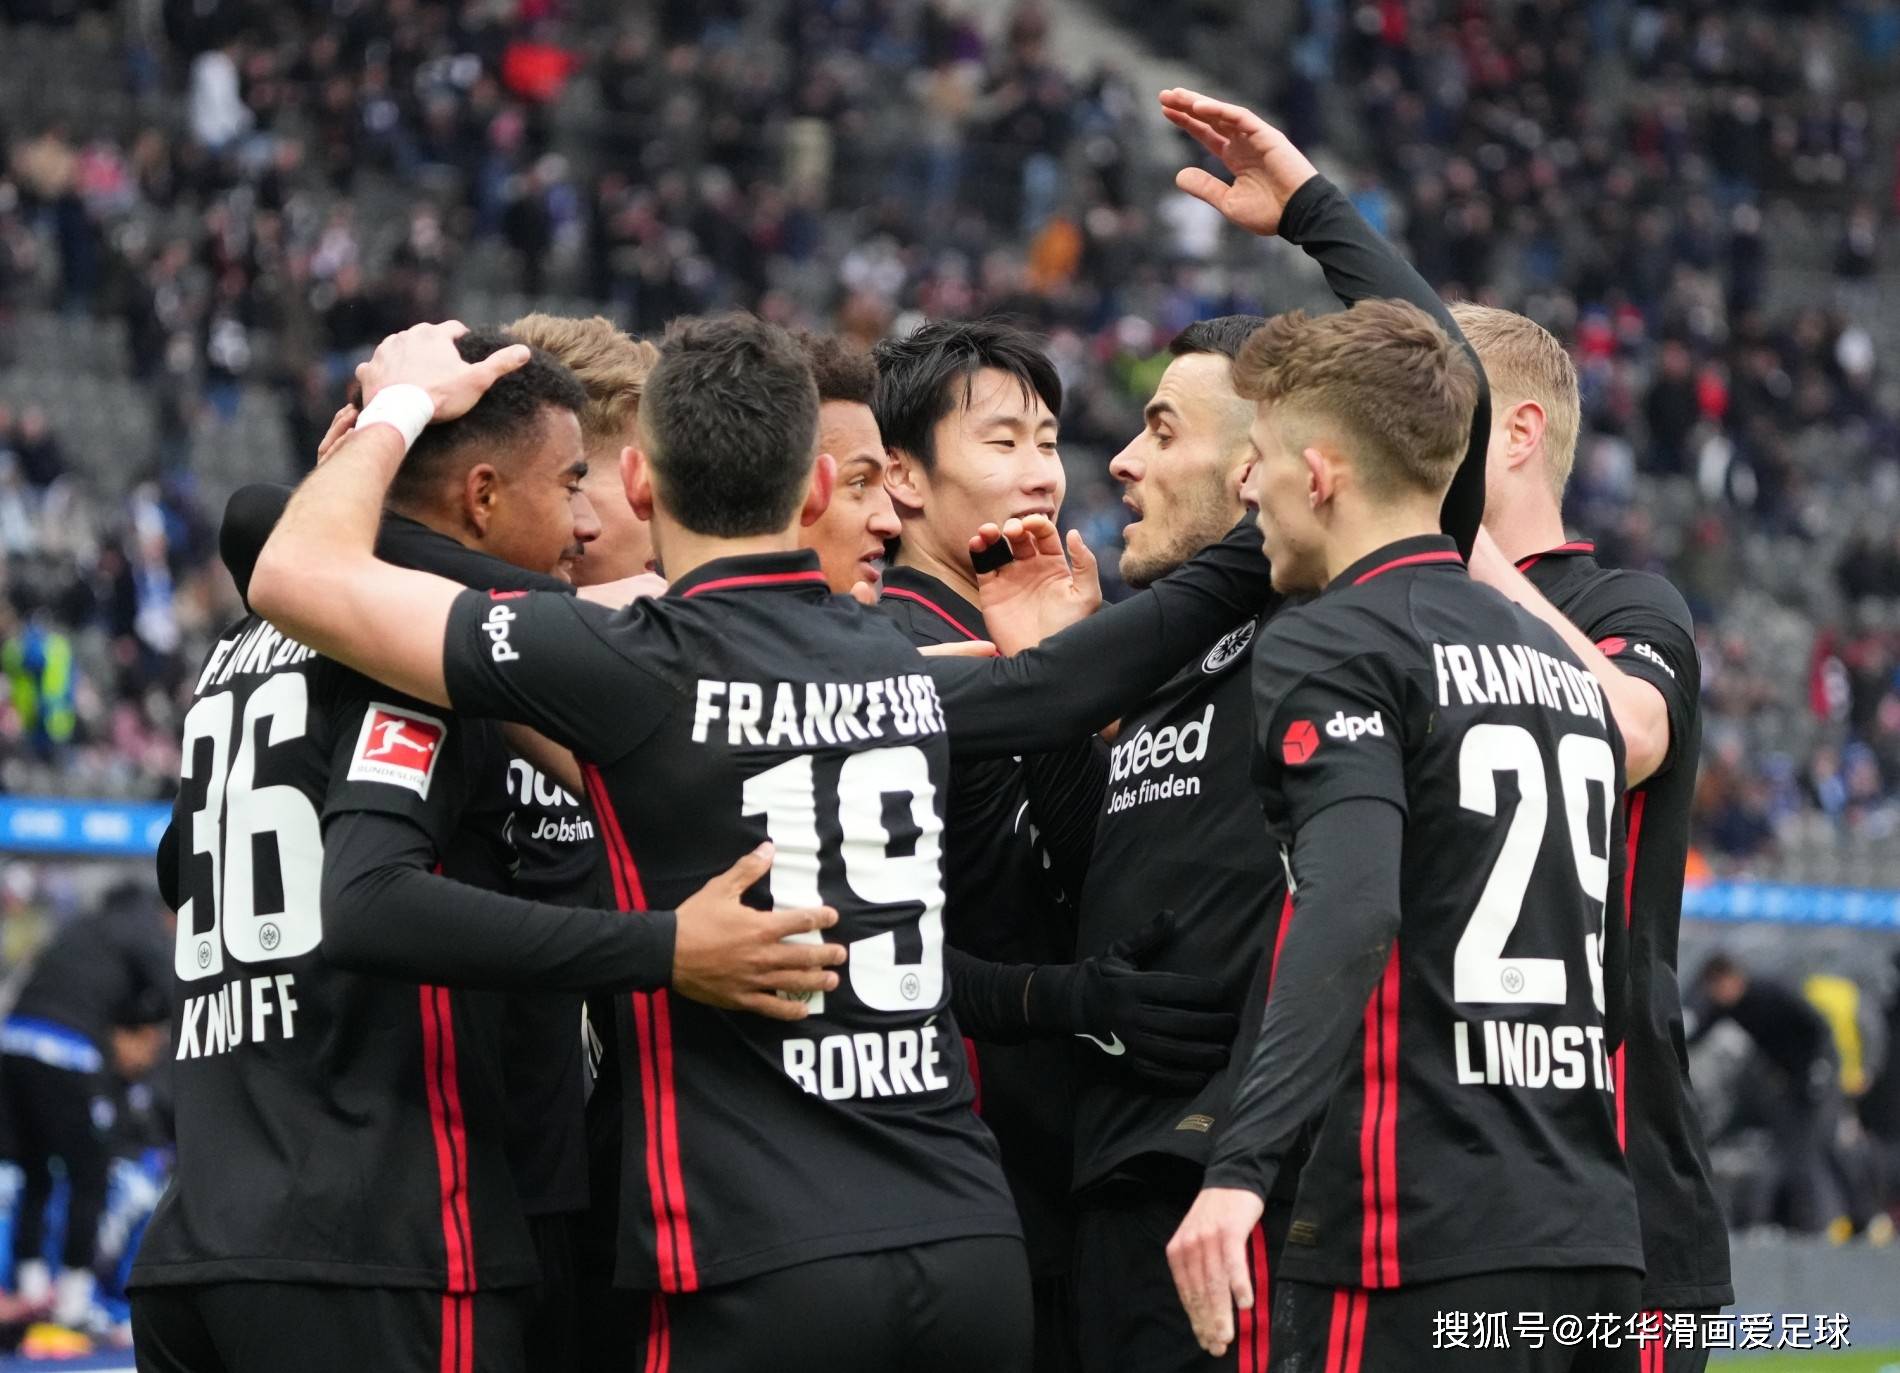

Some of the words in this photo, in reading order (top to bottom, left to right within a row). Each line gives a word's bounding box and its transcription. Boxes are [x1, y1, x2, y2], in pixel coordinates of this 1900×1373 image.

[482, 604, 519, 662] dpd
[1325, 710, 1385, 742] dpd
[175, 672, 325, 982] 36
[1107, 786, 1137, 815] Jobs
[1138, 773, 1200, 804] finden
[741, 745, 946, 1015] 19
[1453, 723, 1616, 1016] 29
[782, 1014, 950, 1101] BORRÉ
[1453, 1020, 1615, 1093] LINDST
